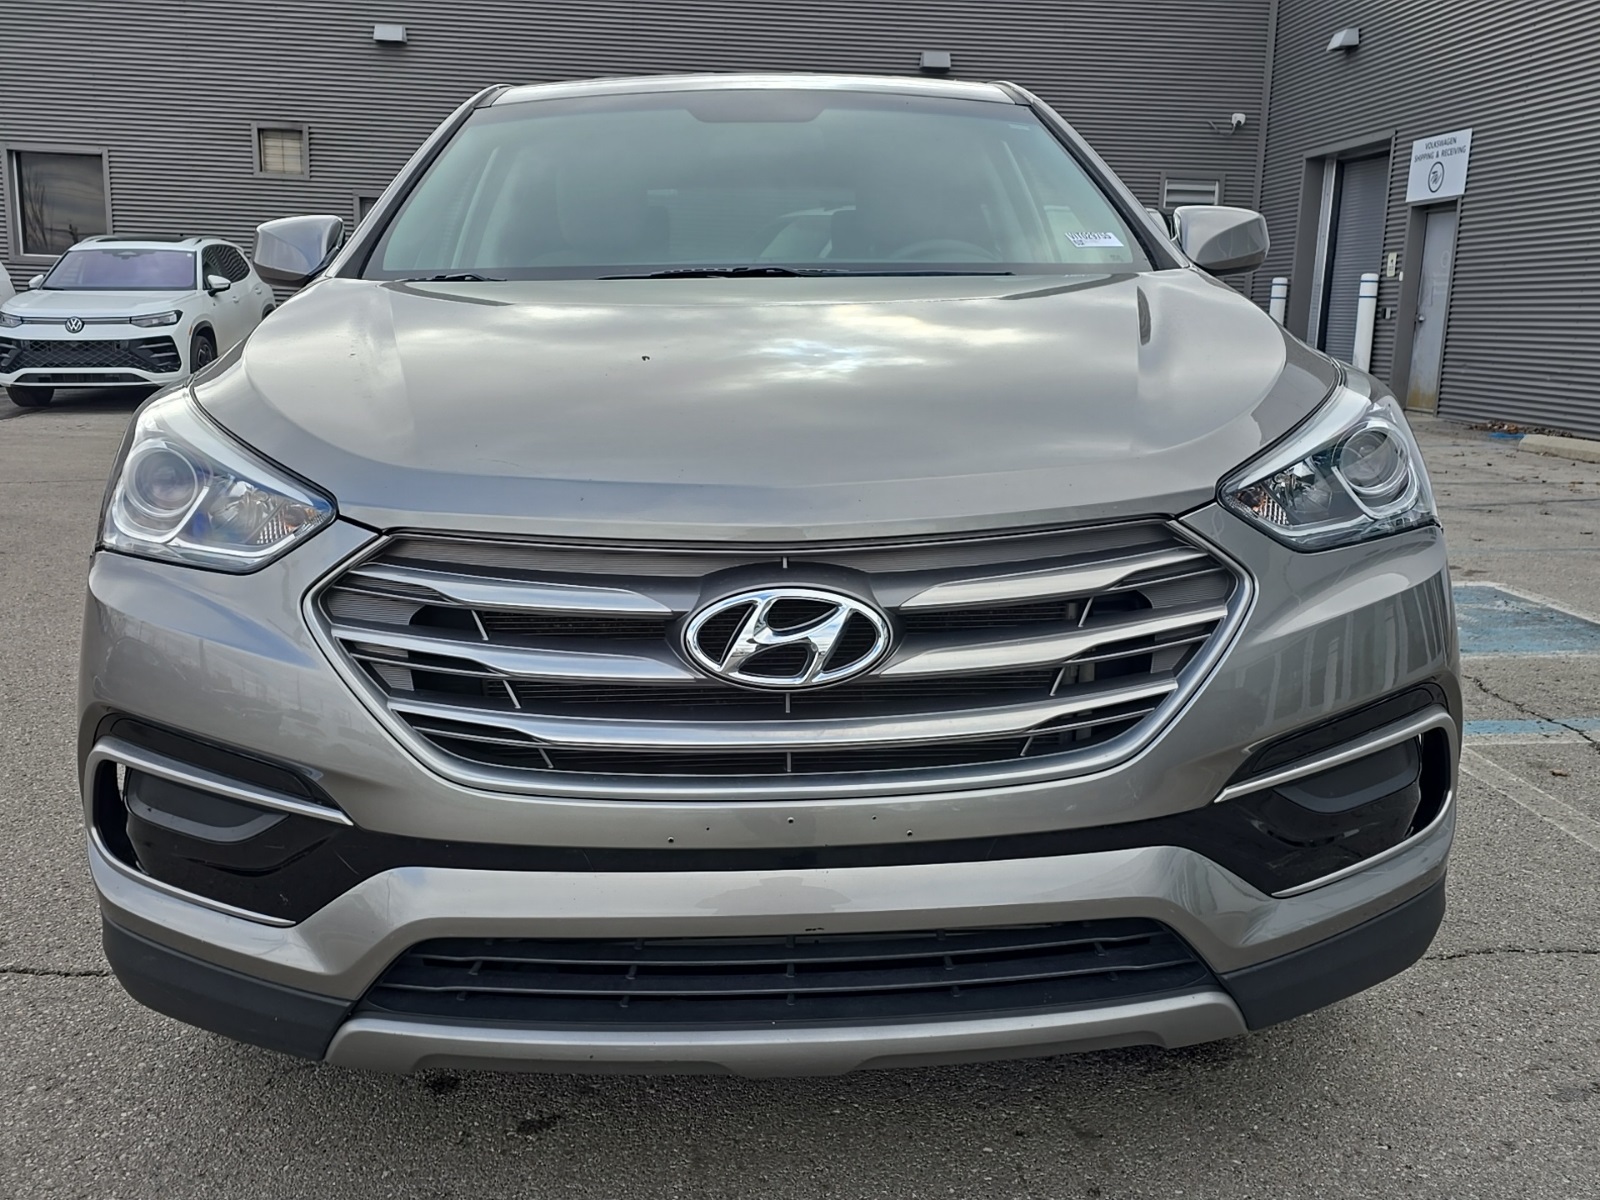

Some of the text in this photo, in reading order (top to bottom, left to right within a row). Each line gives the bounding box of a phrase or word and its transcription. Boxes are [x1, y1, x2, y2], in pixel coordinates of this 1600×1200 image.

[1425, 137, 1457, 150] VOLKSWAGEN
[1414, 145, 1466, 163] SHIPPING & RECEIVING
